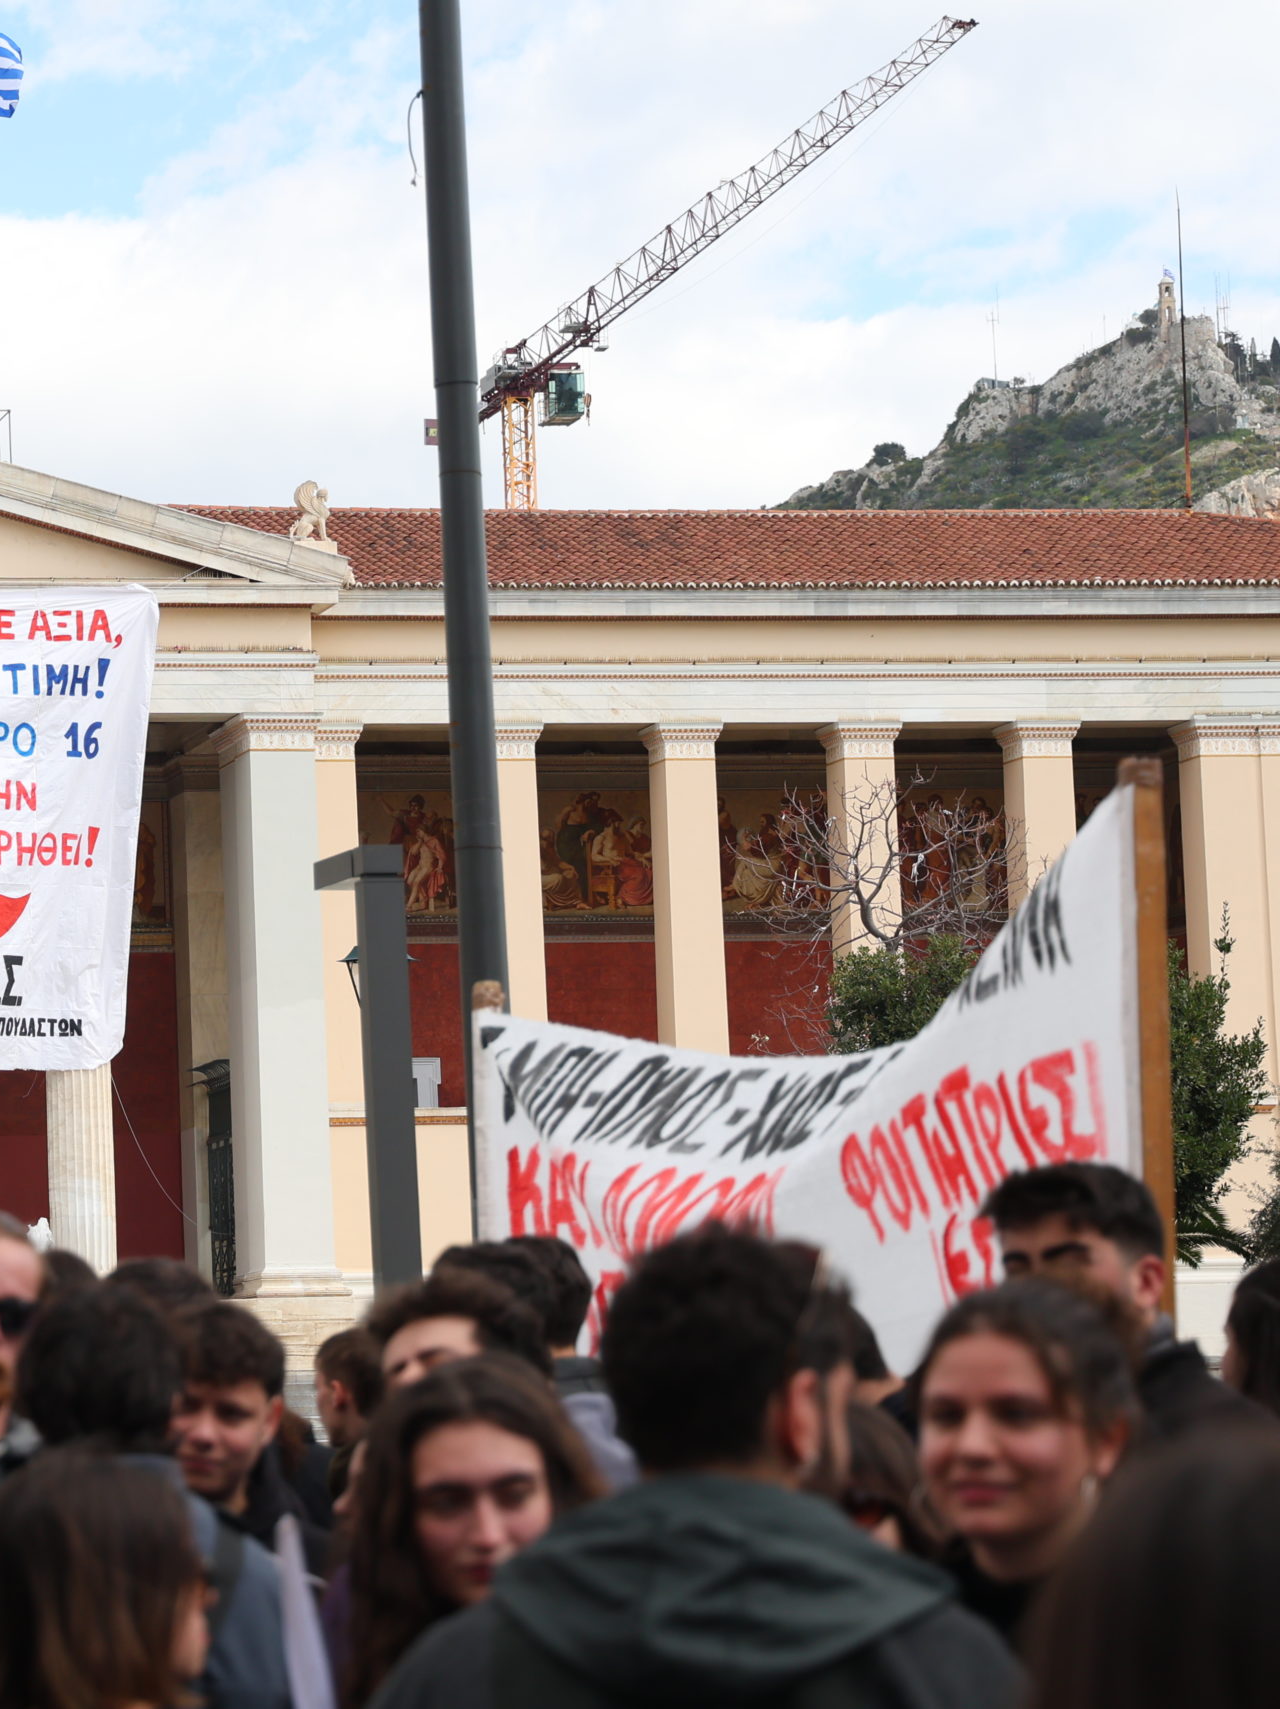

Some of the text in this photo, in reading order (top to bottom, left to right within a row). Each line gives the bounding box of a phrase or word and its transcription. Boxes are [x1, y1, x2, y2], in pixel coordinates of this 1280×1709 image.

[28, 609, 123, 649] ΑΞΙΑ,
[2, 658, 111, 699] ΤΙΜΗ!
[64, 721, 103, 759] 16
